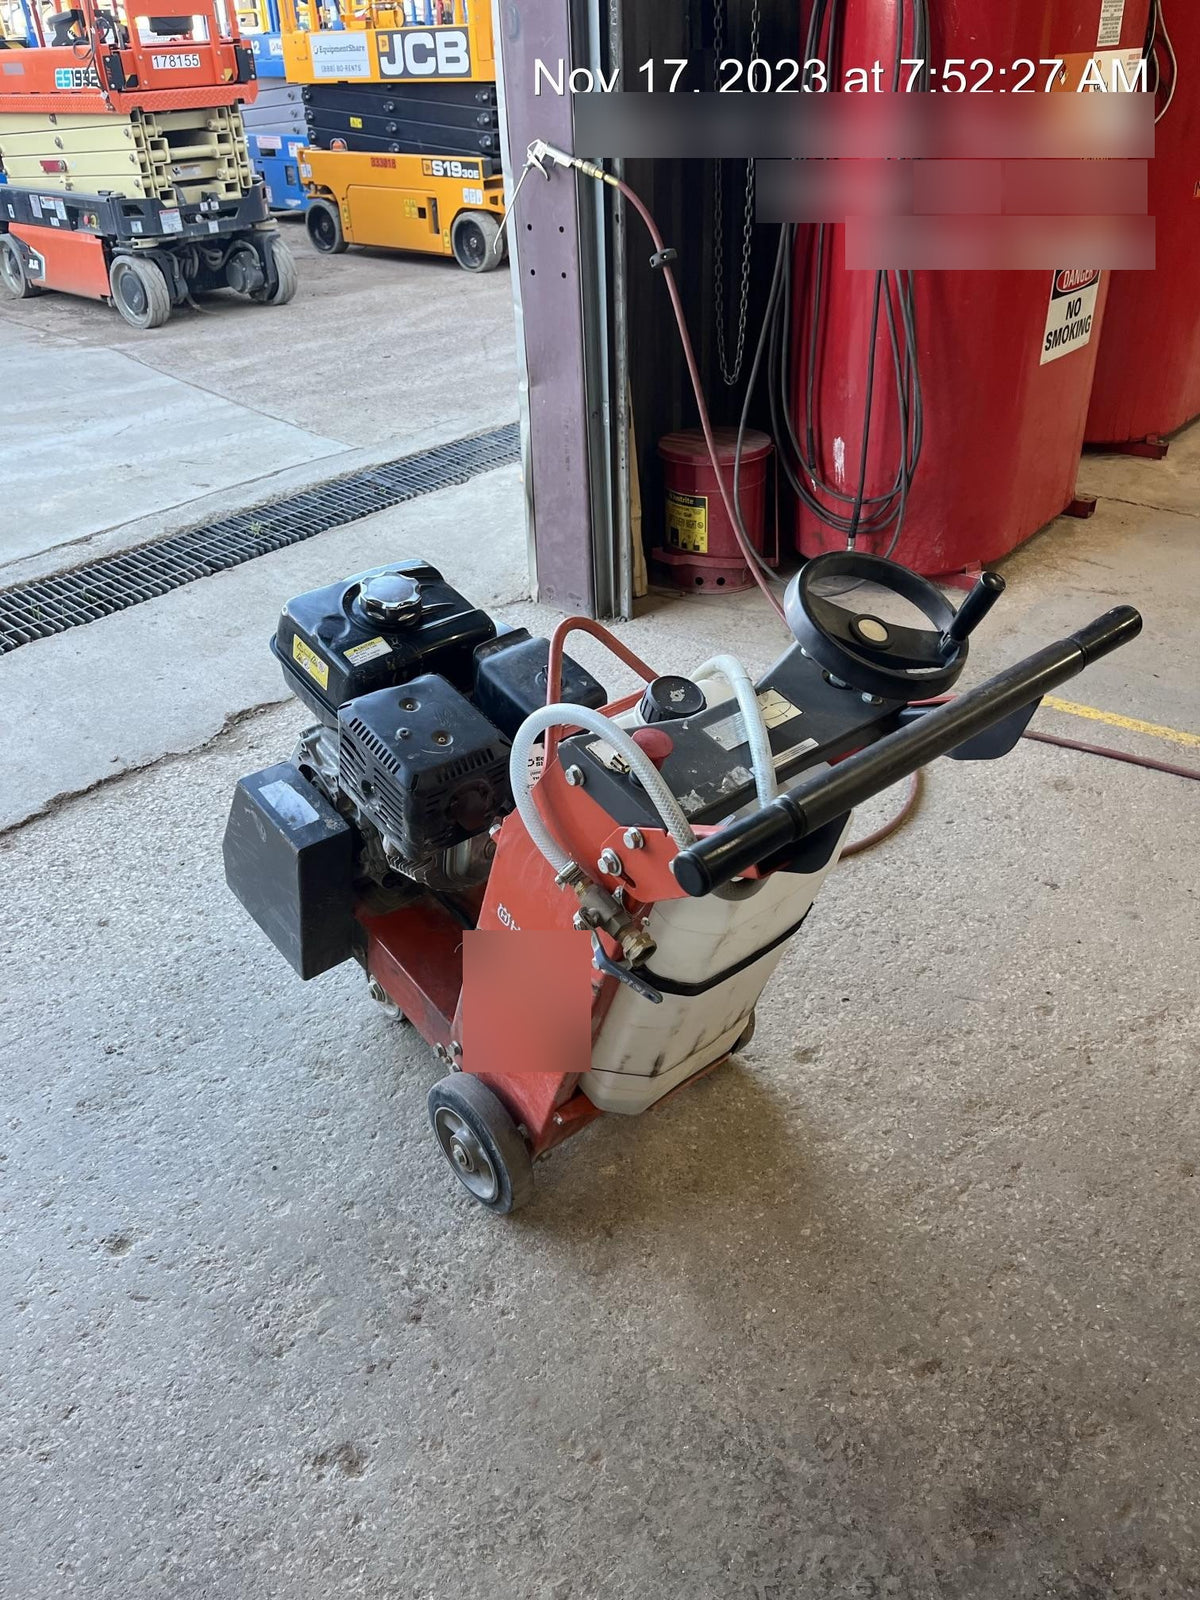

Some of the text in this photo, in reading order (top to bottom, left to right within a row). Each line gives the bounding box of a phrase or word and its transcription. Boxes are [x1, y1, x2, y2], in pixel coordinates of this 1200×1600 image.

[153, 54, 199, 68] 178155
[380, 31, 470, 75] JCB
[1065, 297, 1082, 320] NO
[1044, 315, 1092, 351] SMOKING
